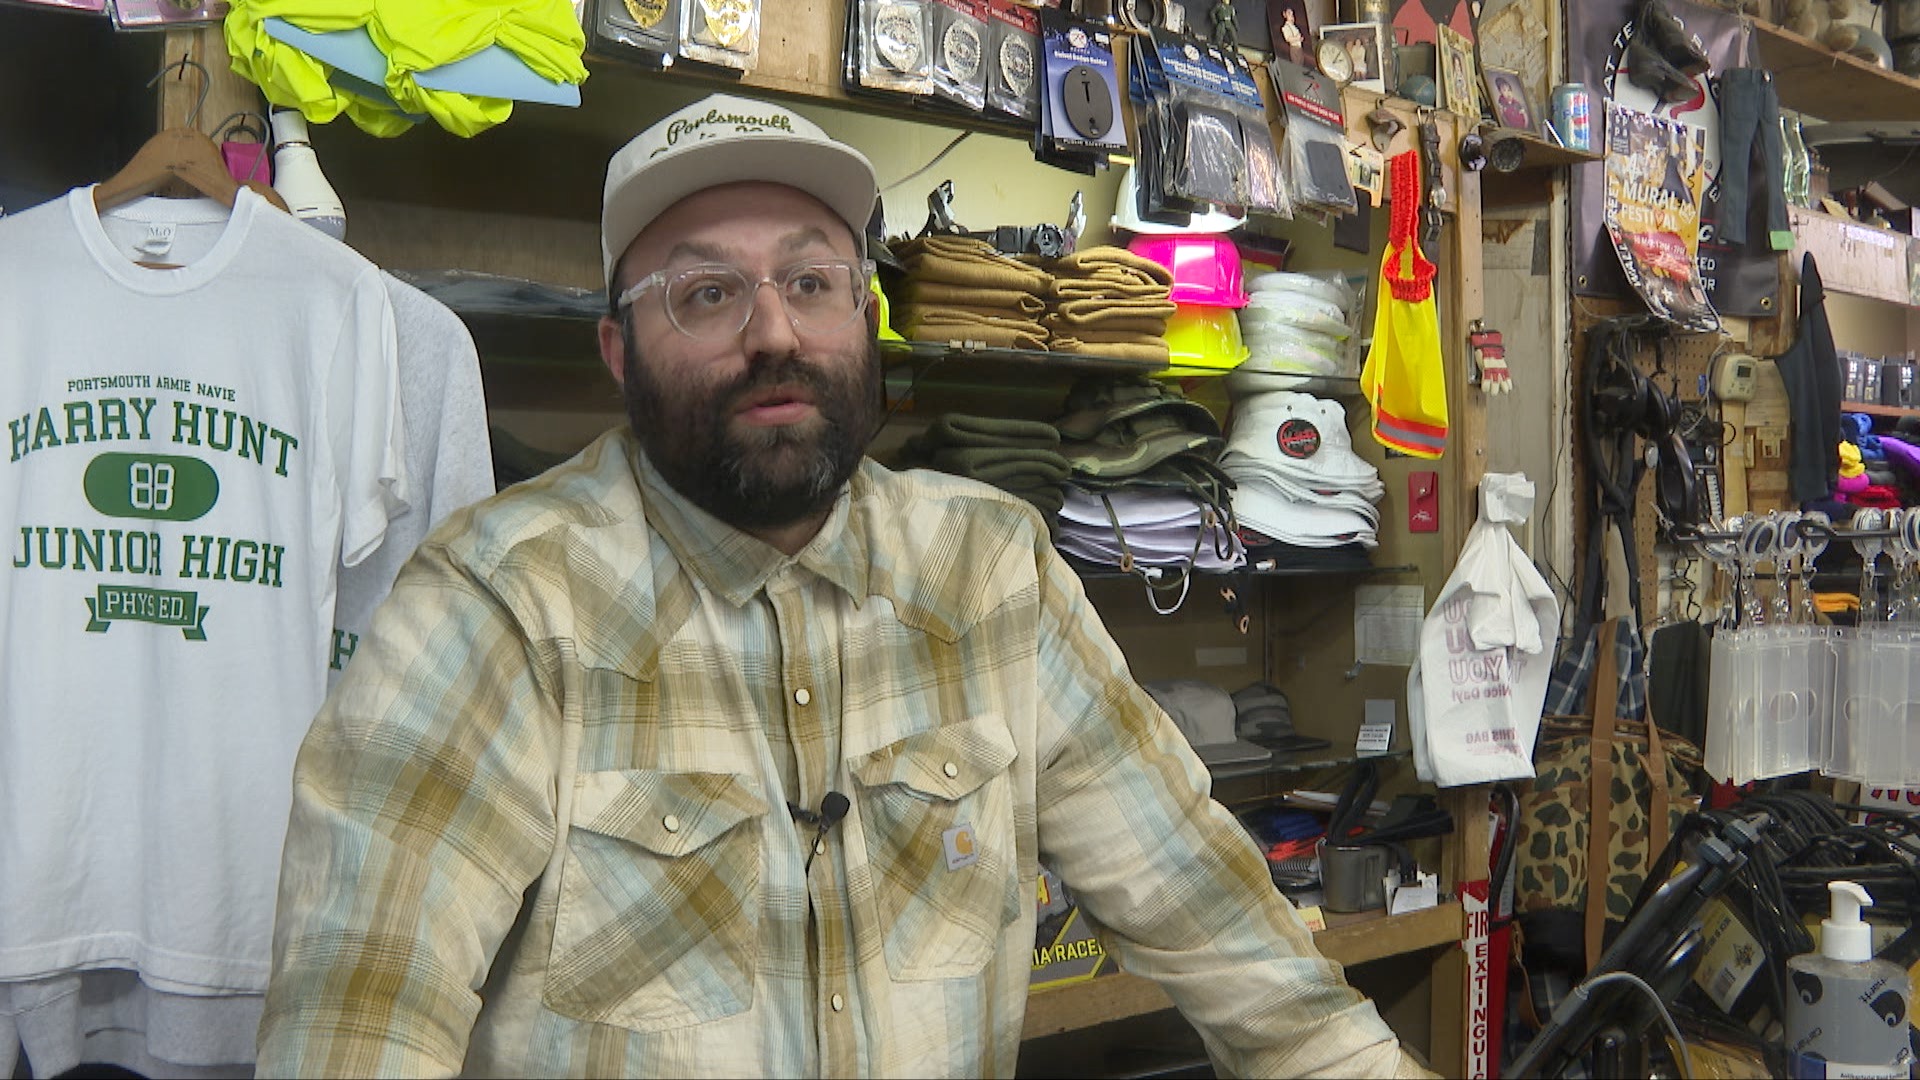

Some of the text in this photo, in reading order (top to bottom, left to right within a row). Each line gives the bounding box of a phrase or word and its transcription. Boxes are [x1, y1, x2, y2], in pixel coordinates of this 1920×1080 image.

[667, 109, 795, 145] Portsmouth
[1623, 179, 1679, 211] MURAL
[67, 375, 236, 402] PORTSMOUTH ARMIE NAVIE
[8, 397, 299, 477] HARRY HUNT
[129, 460, 176, 512] 88
[13, 526, 285, 588] JUNIOR HIGH
[105, 591, 188, 621] PHYS ED.
[1467, 911, 1489, 939] FIR
[1055, 938, 1103, 962] RACE
